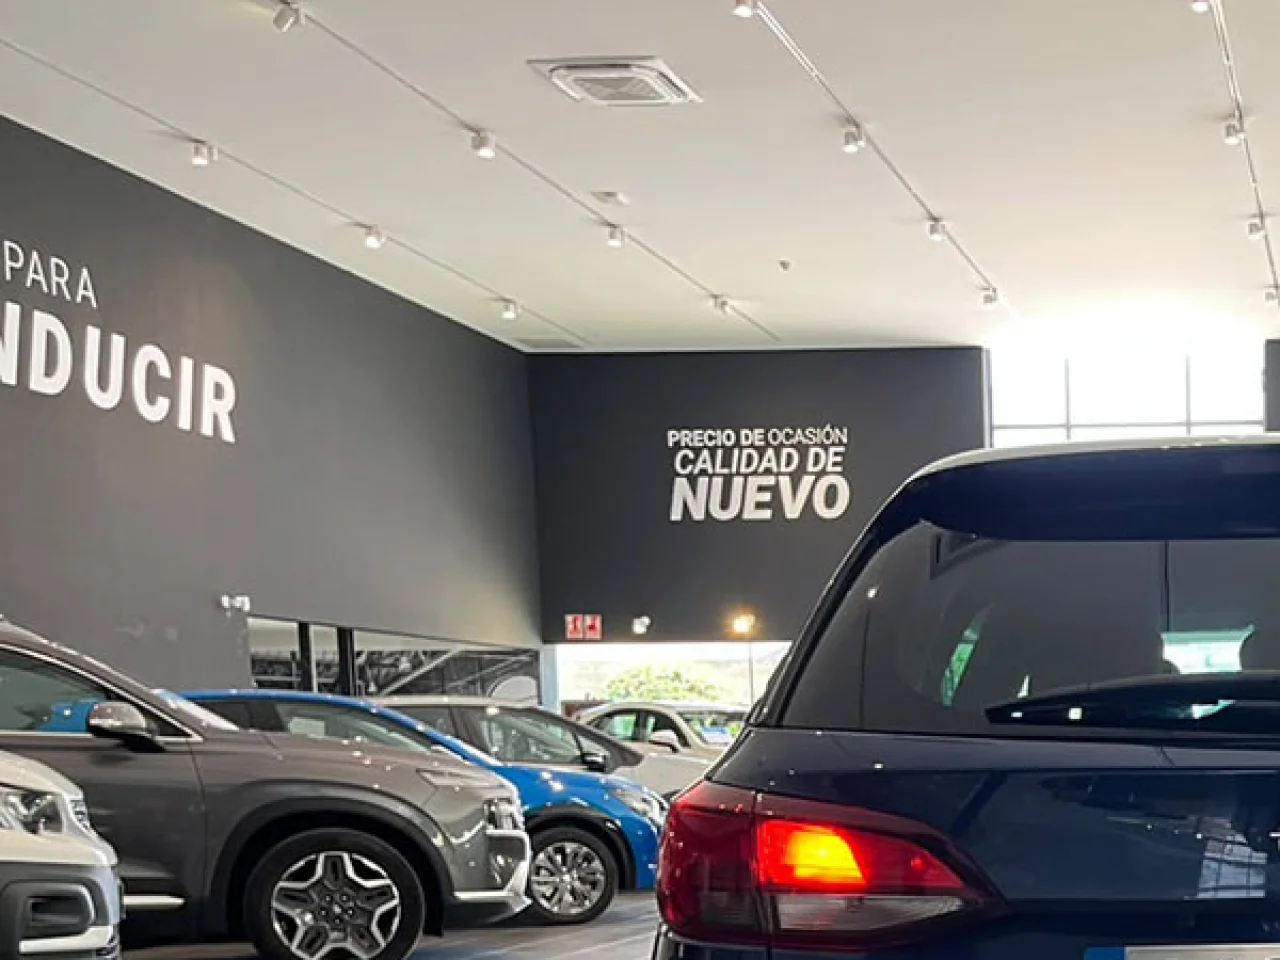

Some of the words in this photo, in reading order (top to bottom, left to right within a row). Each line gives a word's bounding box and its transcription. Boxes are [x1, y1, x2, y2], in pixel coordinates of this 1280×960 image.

[3, 240, 97, 308] PARA
[667, 428, 736, 447] PRECIO
[739, 428, 766, 446] DE
[767, 423, 848, 446] OCASIÓN
[674, 447, 799, 475] CALIDAD
[805, 447, 846, 473] DE
[669, 473, 850, 521] NUEVO
